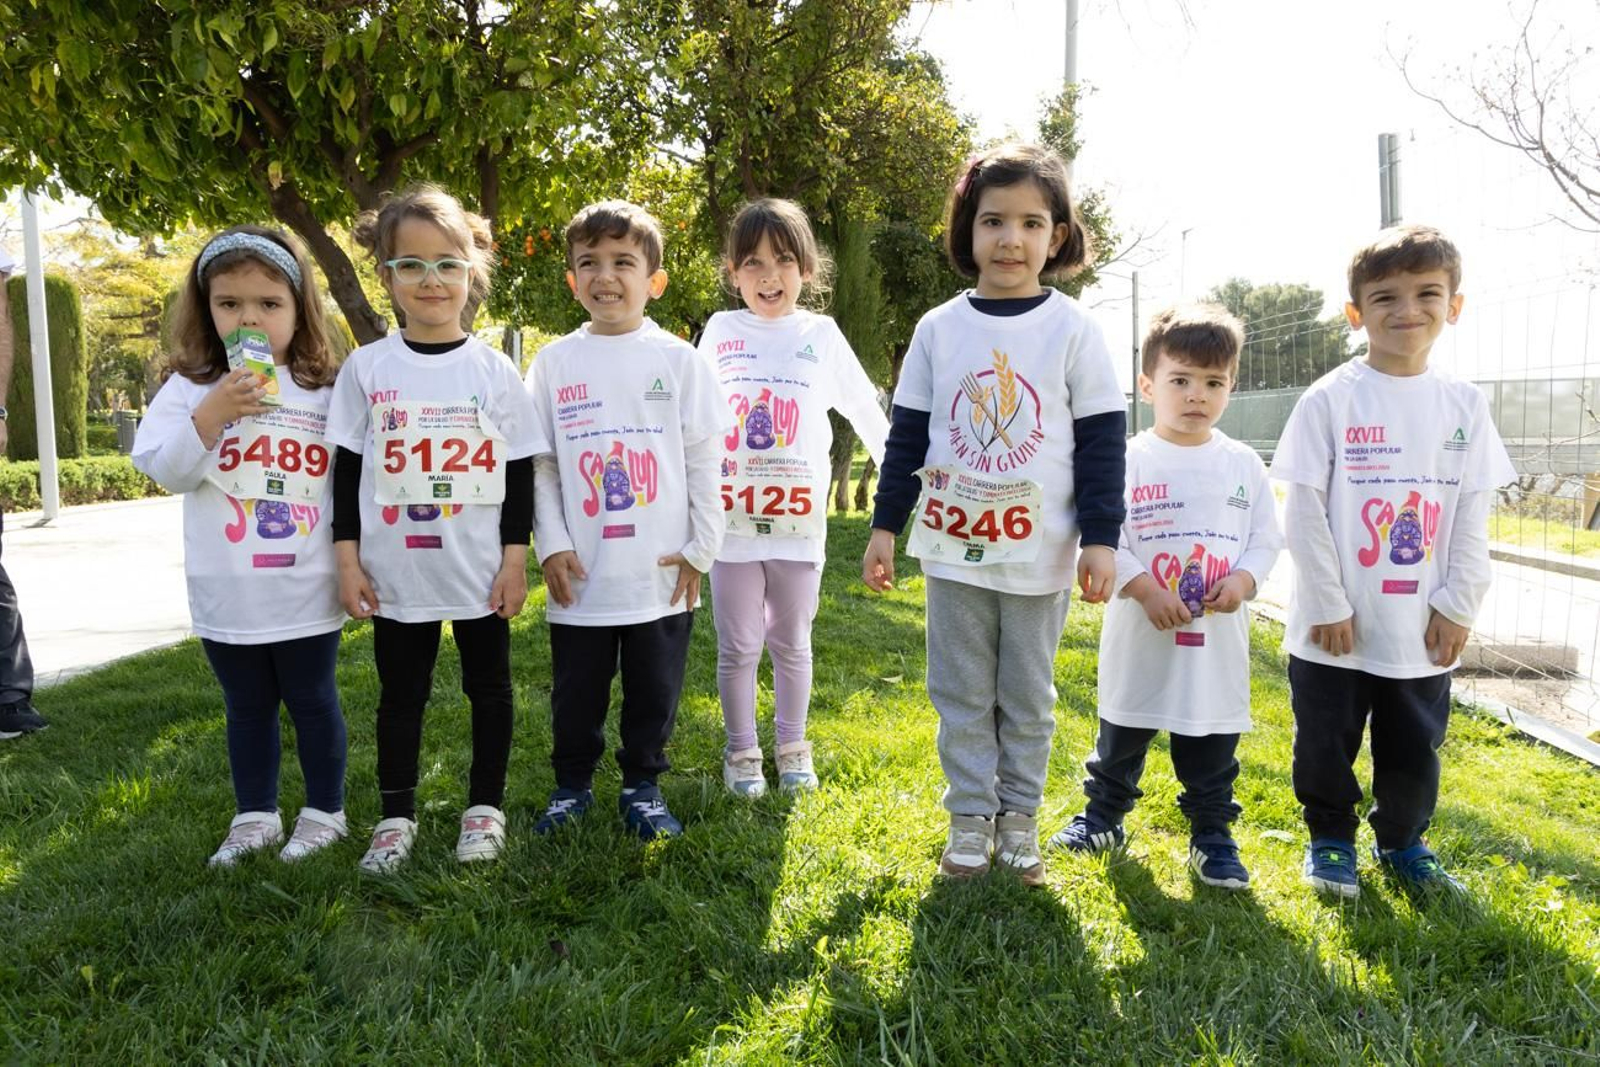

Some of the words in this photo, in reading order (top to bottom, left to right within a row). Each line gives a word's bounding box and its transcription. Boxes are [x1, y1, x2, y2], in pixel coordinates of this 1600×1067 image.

[717, 340, 745, 355] XXVII
[557, 384, 588, 404] XXVII
[1345, 427, 1385, 443] XXVII
[218, 435, 329, 477] 5489
[384, 438, 497, 474] 5124
[967, 450, 991, 473] SIN
[264, 471, 287, 480] PAULA
[428, 474, 454, 482] MARÍA
[579, 449, 658, 517] SALUD
[721, 485, 812, 516] 5125
[1132, 484, 1168, 503] XXVII
[1131, 504, 1153, 514] CARRERA
[1154, 502, 1185, 511] POPULAR
[922, 497, 1033, 542] 5246
